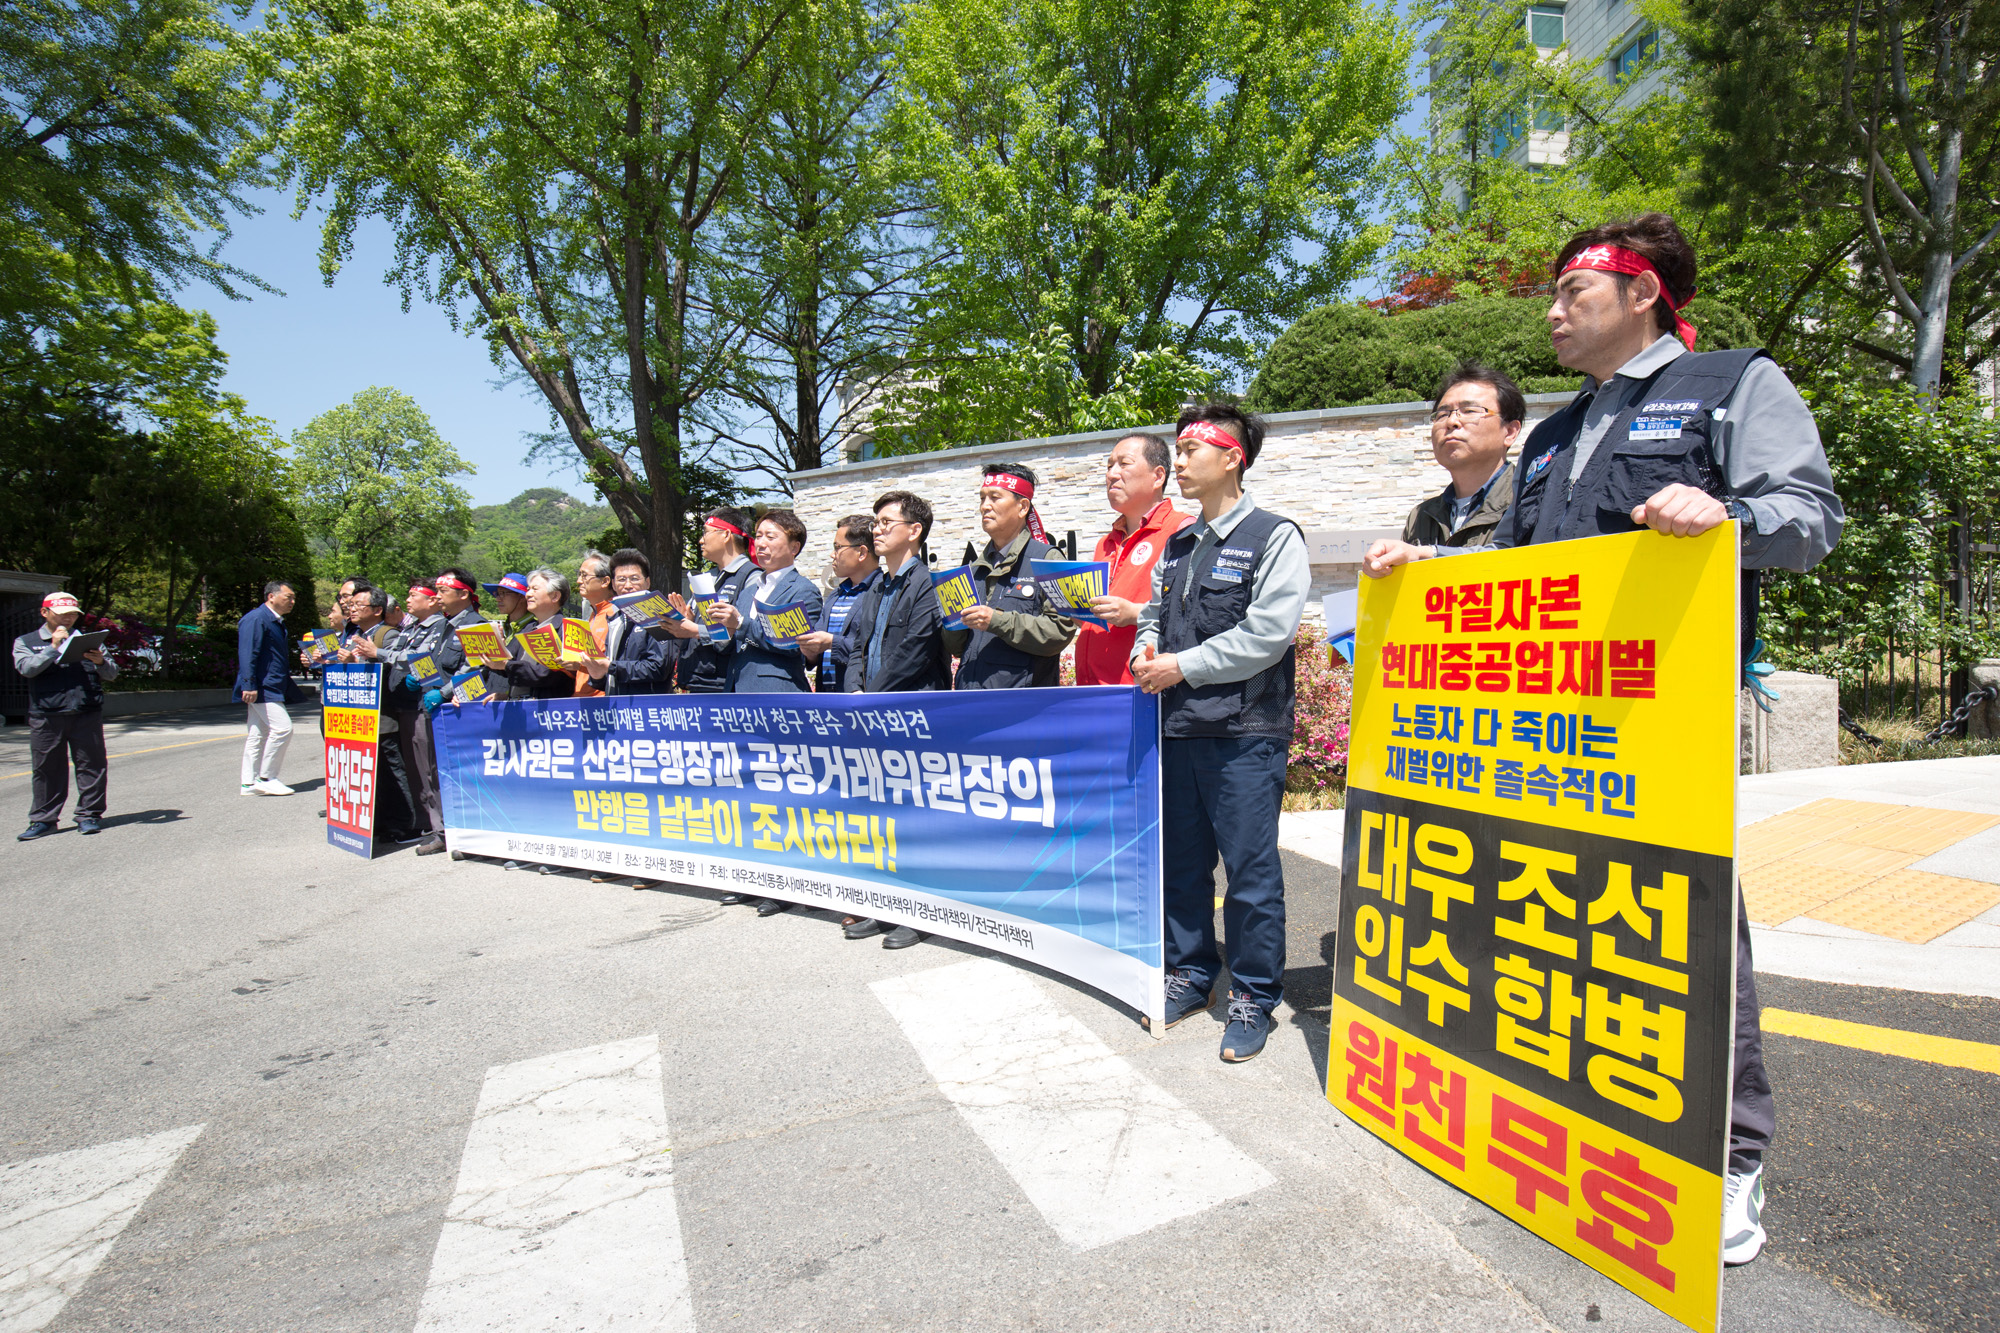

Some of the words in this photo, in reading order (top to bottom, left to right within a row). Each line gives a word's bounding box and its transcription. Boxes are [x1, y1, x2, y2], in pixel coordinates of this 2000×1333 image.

[1320, 540, 1350, 554] and
[1424, 573, 1582, 633] 악질자본
[326, 671, 348, 686] 무책임한
[348, 672, 378, 687] 산업은행과
[326, 688, 348, 704] 악질자본
[348, 689, 377, 705] 현대중공업
[327, 712, 350, 734] 대우조선
[351, 714, 376, 737] 졸속매각
[593, 707, 645, 732] 현대재벌
[710, 706, 770, 733] 국민감사
[770, 708, 804, 735] 청구
[805, 708, 844, 736] 접수
[845, 708, 933, 740] 기자회견
[1390, 702, 1465, 744] 노동자
[1472, 706, 1503, 748] 다
[1511, 709, 1619, 761] 죽이는
[327, 743, 374, 831] 원천무효
[481, 738, 576, 780] 감사원은
[581, 739, 744, 790] 산업은행장과
[748, 742, 1056, 829] 공정거래위원장의
[1384, 744, 1485, 795] 재벌위한
[1493, 757, 1636, 820] 졸속적인
[572, 789, 651, 837] 만행을
[657, 794, 743, 848] 낱낱이
[749, 802, 898, 873] 조사하라!
[507, 839, 521, 852] 일시:
[523, 841, 544, 855] 2019년
[545, 843, 556, 856] 5월
[558, 845, 579, 859] 7일(화)
[581, 848, 595, 862] 13시
[596, 850, 612, 864] 30분
[624, 853, 642, 867] 장소:
[644, 856, 667, 871] 감사원
[669, 859, 685, 874] 정문
[687, 861, 696, 876] 앞
[709, 864, 728, 880] 주최:
[731, 868, 833, 899] 대우조선(동종사)매각반대
[1353, 903, 1471, 1028] 인수
[1493, 952, 1688, 1124] 합병
